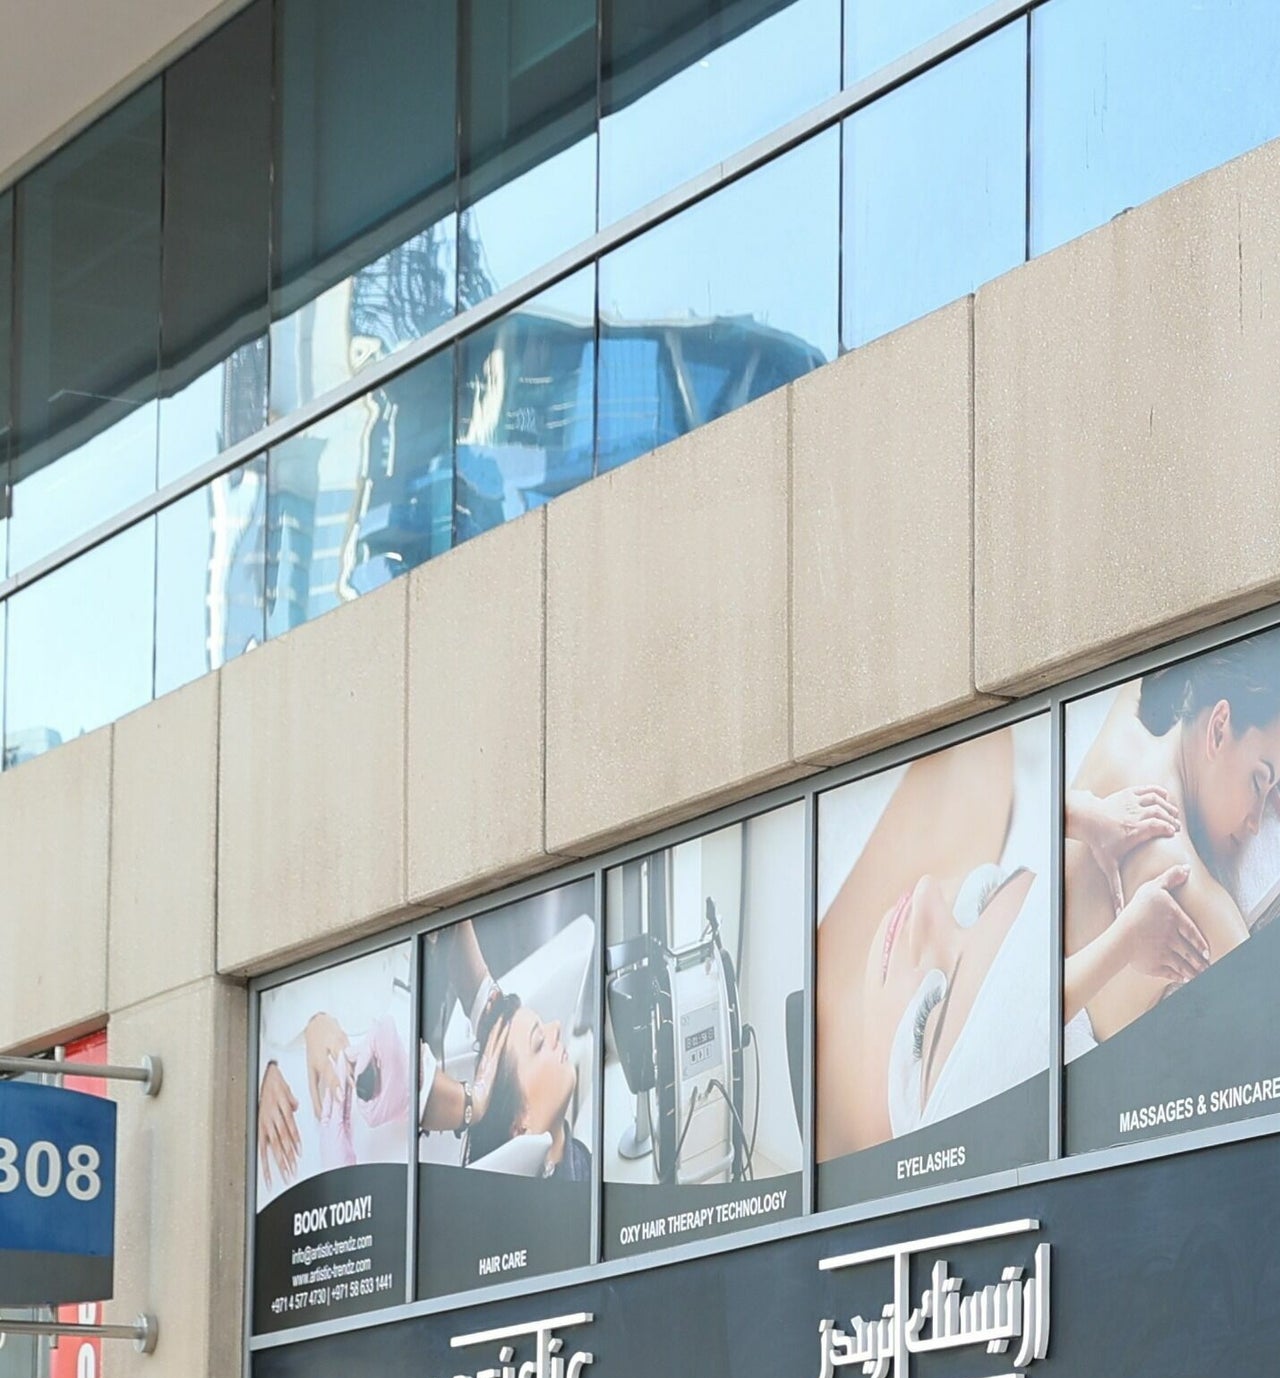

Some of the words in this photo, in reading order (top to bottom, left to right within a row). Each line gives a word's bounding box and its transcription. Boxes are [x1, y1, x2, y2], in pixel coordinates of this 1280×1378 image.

[1120, 1098, 1193, 1132] MASSAGES
[1197, 1095, 1206, 1114] &
[1210, 1077, 1280, 1112] SKINCARE
[898, 1146, 965, 1179] EYELASHES
[620, 1224, 640, 1244] OXY
[642, 1219, 665, 1239] HAIR
[668, 1207, 714, 1233] THERAPY
[716, 1190, 786, 1222] TECHNOLOGY
[480, 1256, 500, 1275] HAIR
[502, 1250, 526, 1270] CARE
